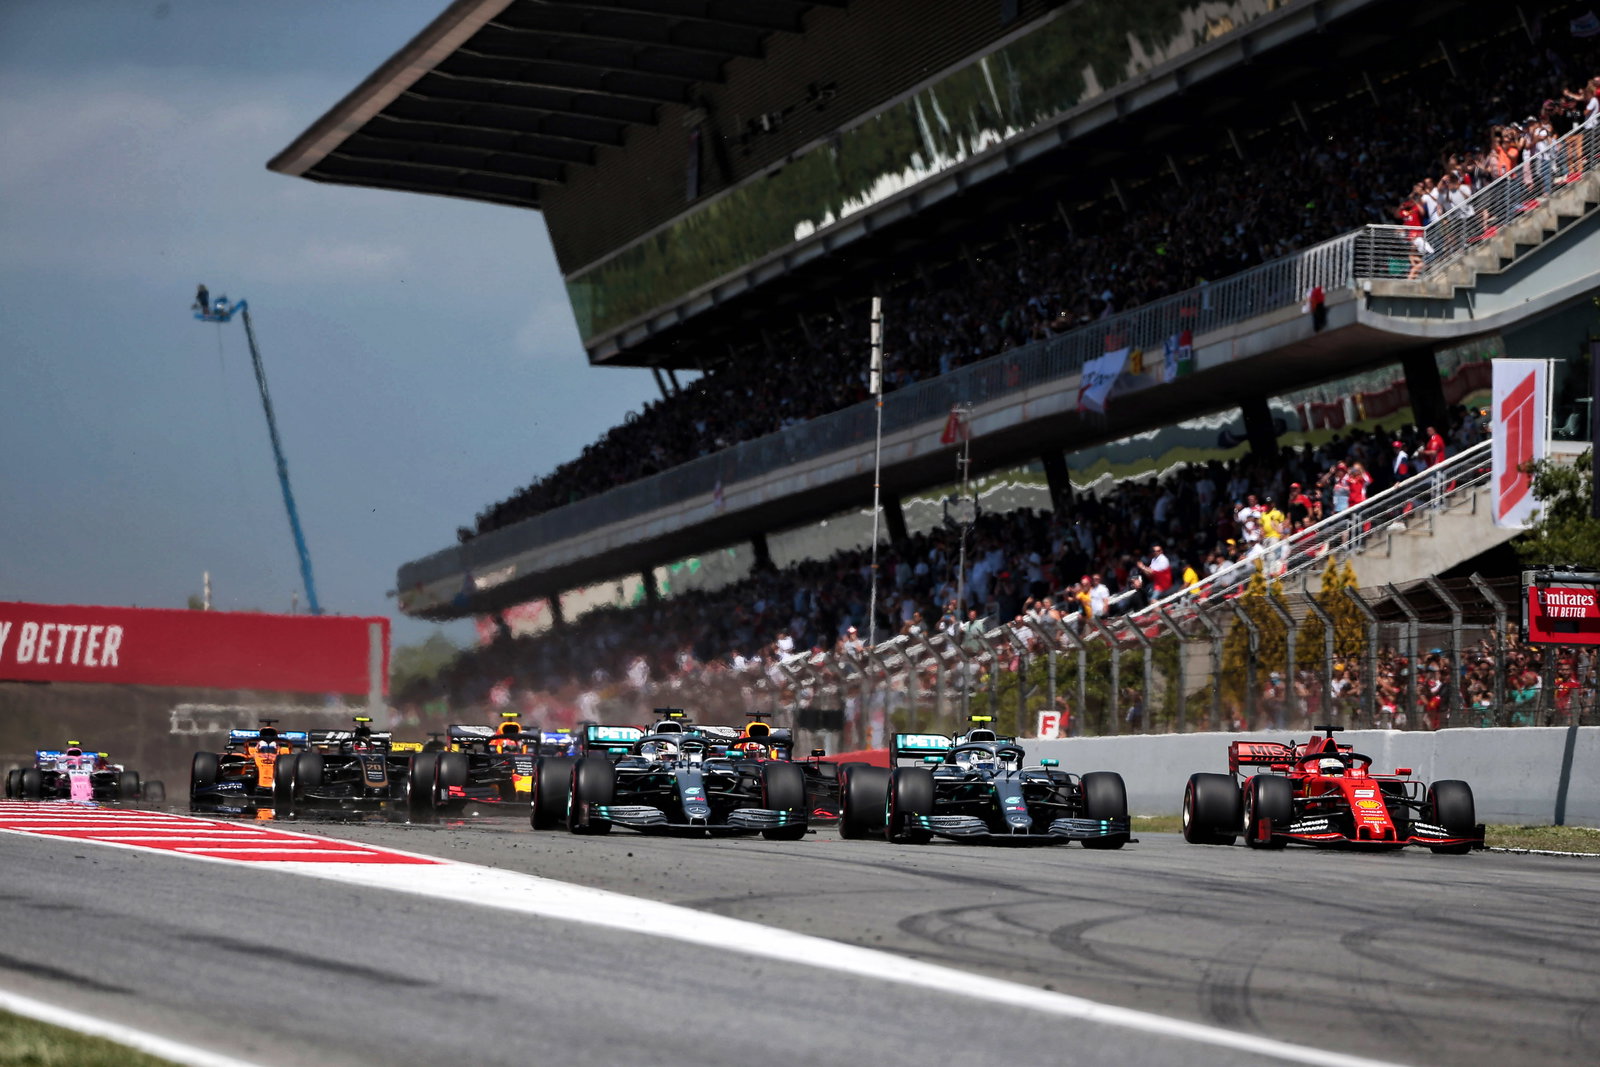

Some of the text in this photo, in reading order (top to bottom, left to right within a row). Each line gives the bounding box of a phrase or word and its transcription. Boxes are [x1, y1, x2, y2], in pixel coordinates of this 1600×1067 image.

[1538, 591, 1594, 606] Emirates
[1547, 606, 1587, 618] FLY BETTER
[16, 621, 124, 667] BETTER
[1041, 715, 1056, 735] F
[598, 726, 645, 740] PETR
[906, 734, 952, 748] PETR
[1353, 789, 1375, 798] 5
